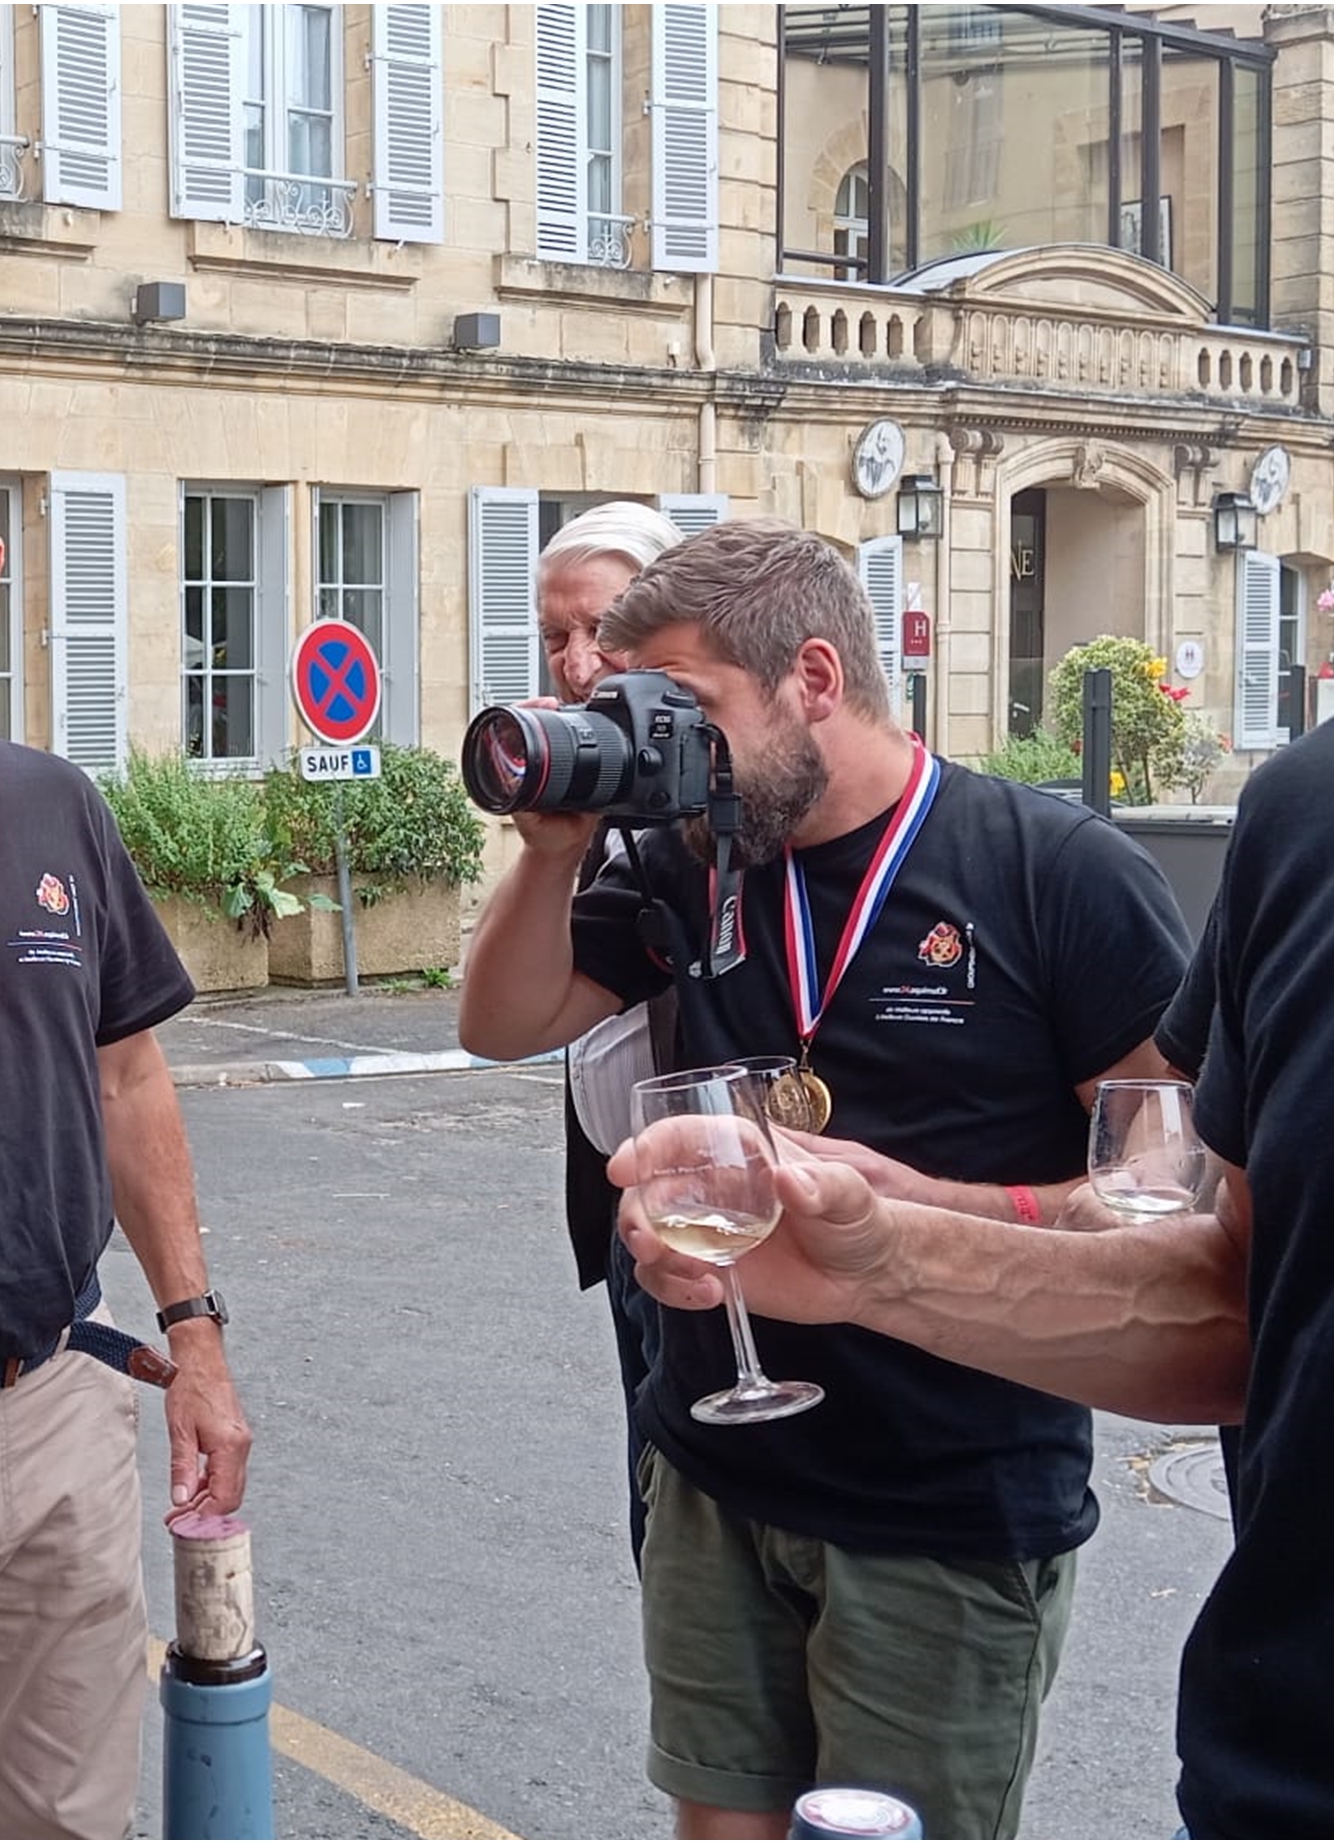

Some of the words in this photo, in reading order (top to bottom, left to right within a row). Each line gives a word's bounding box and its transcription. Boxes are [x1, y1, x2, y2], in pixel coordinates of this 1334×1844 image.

[914, 620, 927, 637] H
[307, 754, 349, 773] SAUF
[715, 895, 738, 955] Canon
